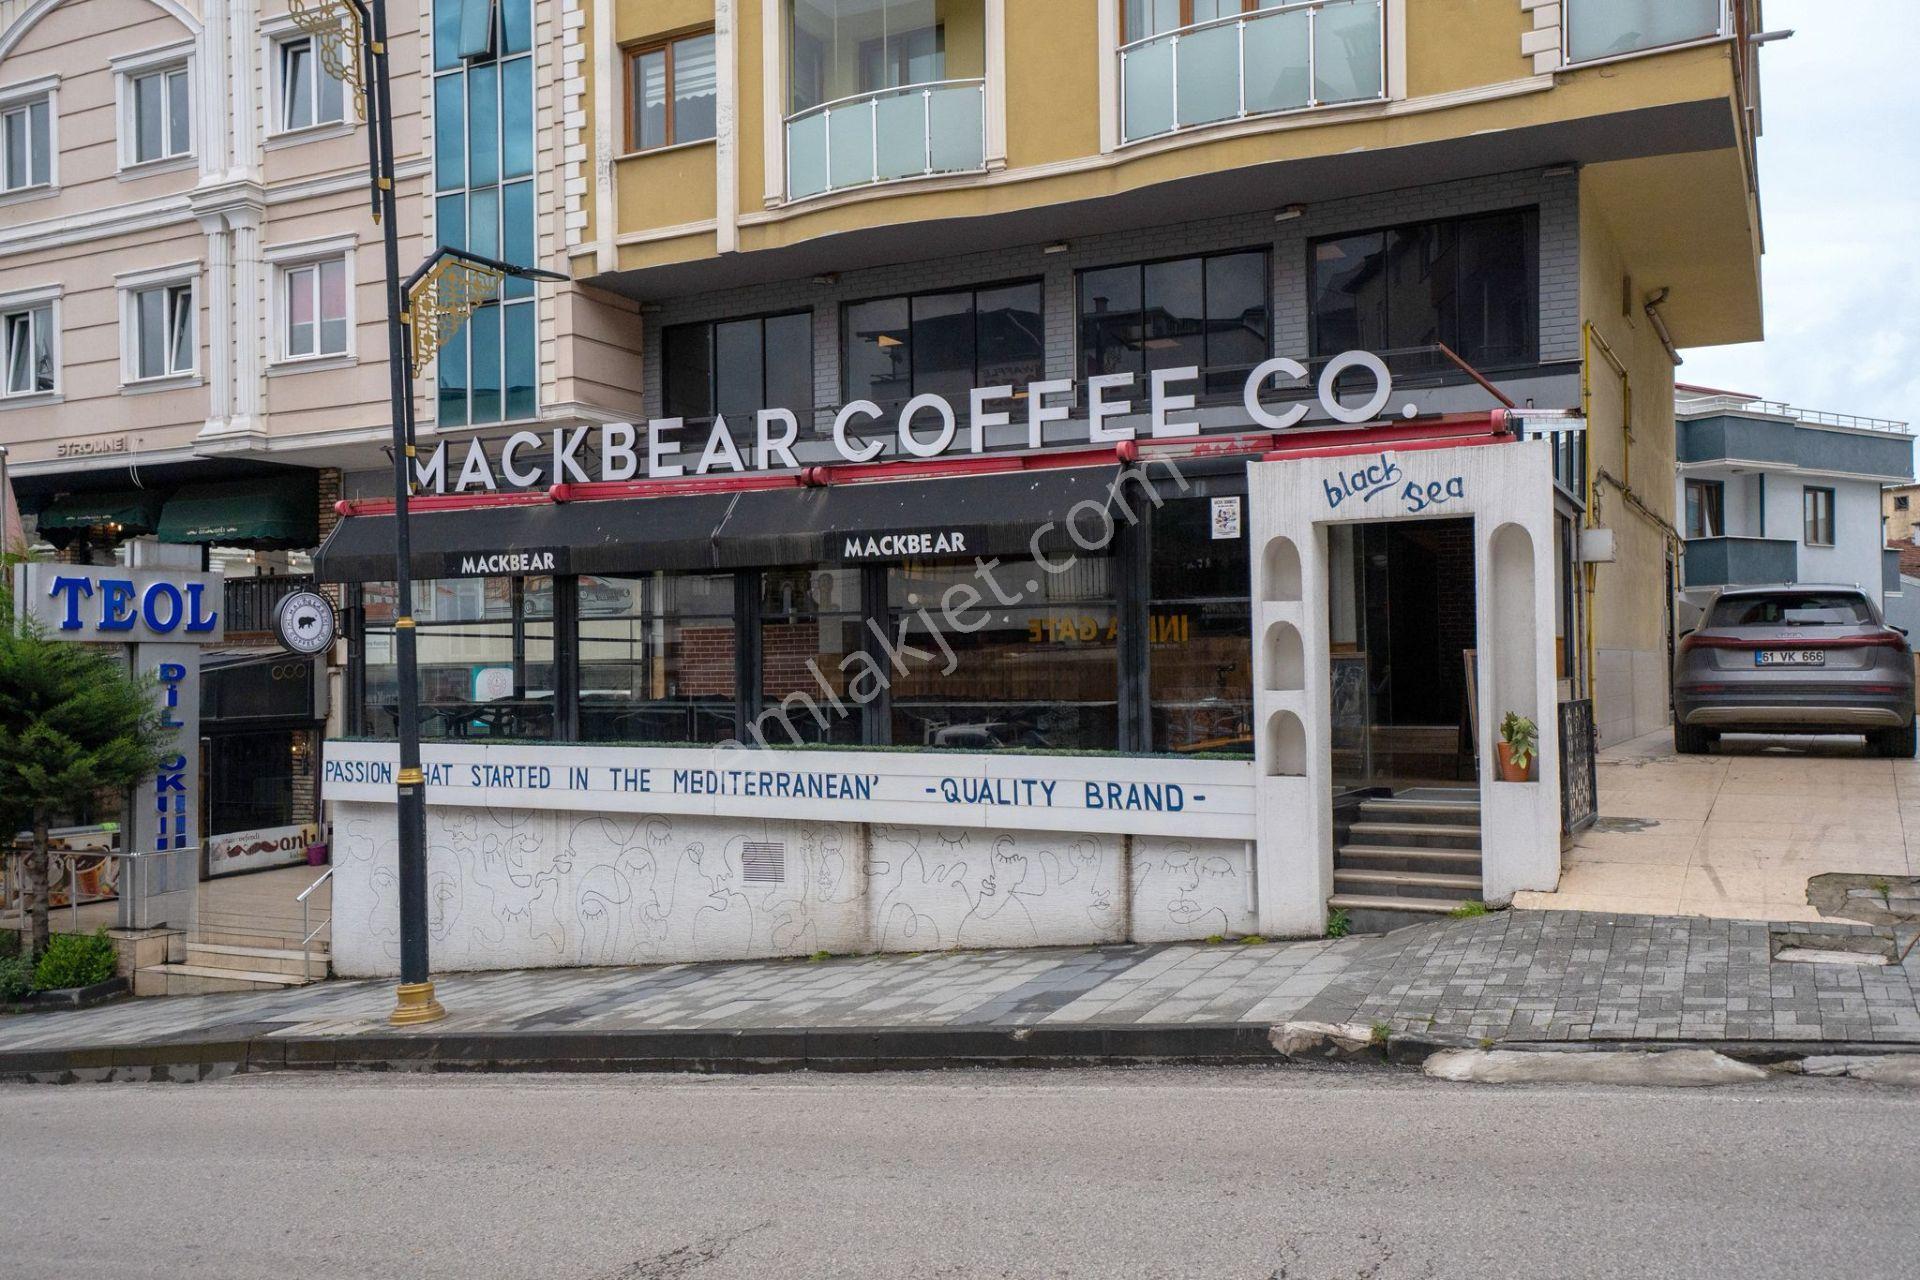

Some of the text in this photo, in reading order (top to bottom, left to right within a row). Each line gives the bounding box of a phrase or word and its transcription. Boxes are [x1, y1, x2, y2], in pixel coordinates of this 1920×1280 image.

[407, 350, 1418, 495] MACKBEAR COFFEE CO.
[1323, 454, 1402, 508] black
[845, 532, 967, 558] MACKBEAR
[461, 552, 555, 575] MACKBEAR
[49, 575, 218, 634] TEOL
[1762, 651, 1823, 662] 61 VK 666
[325, 760, 392, 784] PASSION
[420, 763, 453, 788] HAT
[471, 766, 551, 790] STARTED
[568, 767, 589, 790] IN
[609, 768, 651, 793] THE
